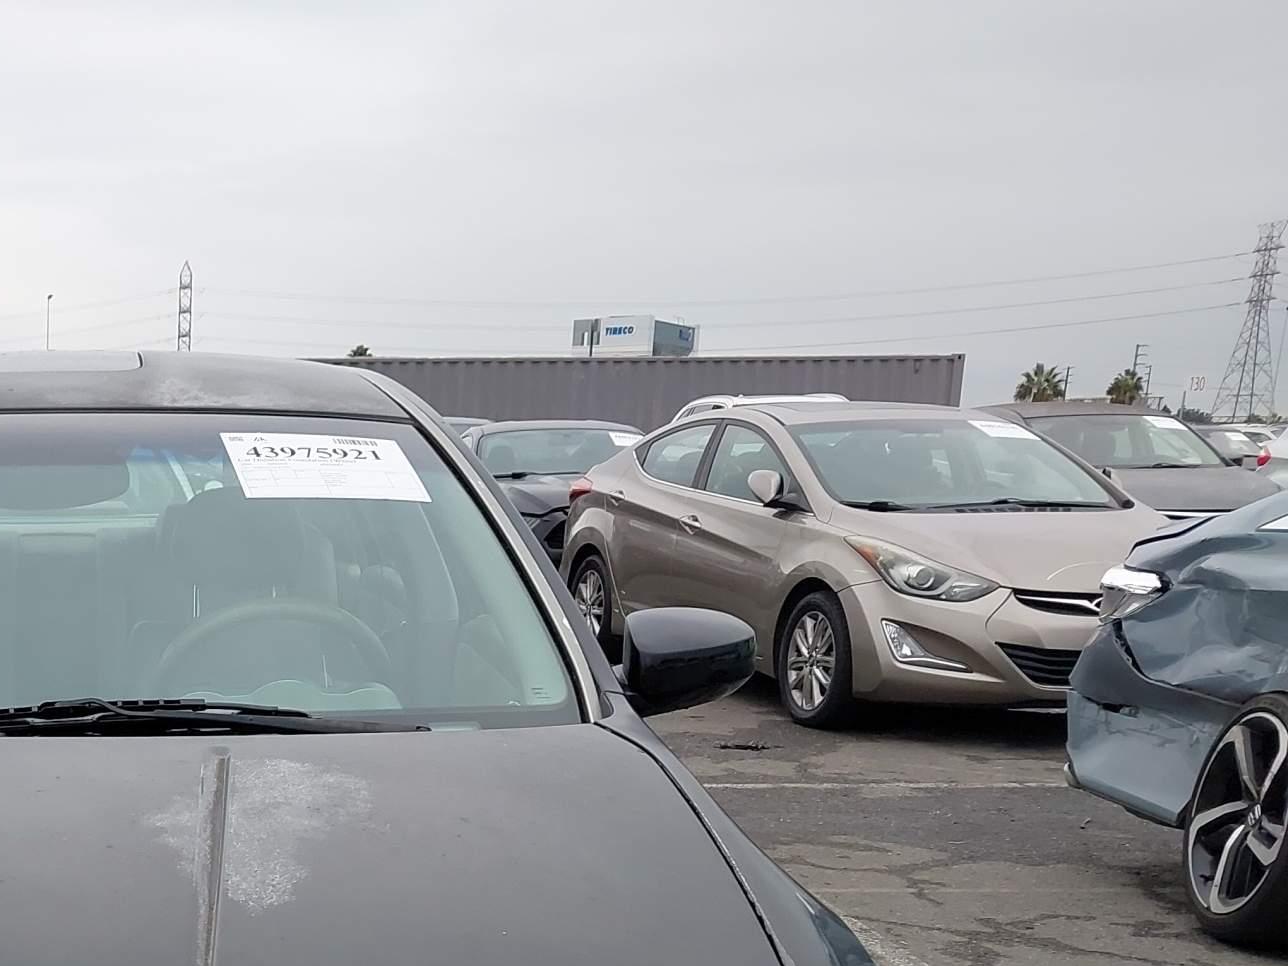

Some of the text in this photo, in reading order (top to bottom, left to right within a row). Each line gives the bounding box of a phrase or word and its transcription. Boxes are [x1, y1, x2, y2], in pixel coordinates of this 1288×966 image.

[605, 326, 634, 336] TIRECO
[1190, 376, 1206, 391] 130
[246, 446, 382, 461] 43975921
